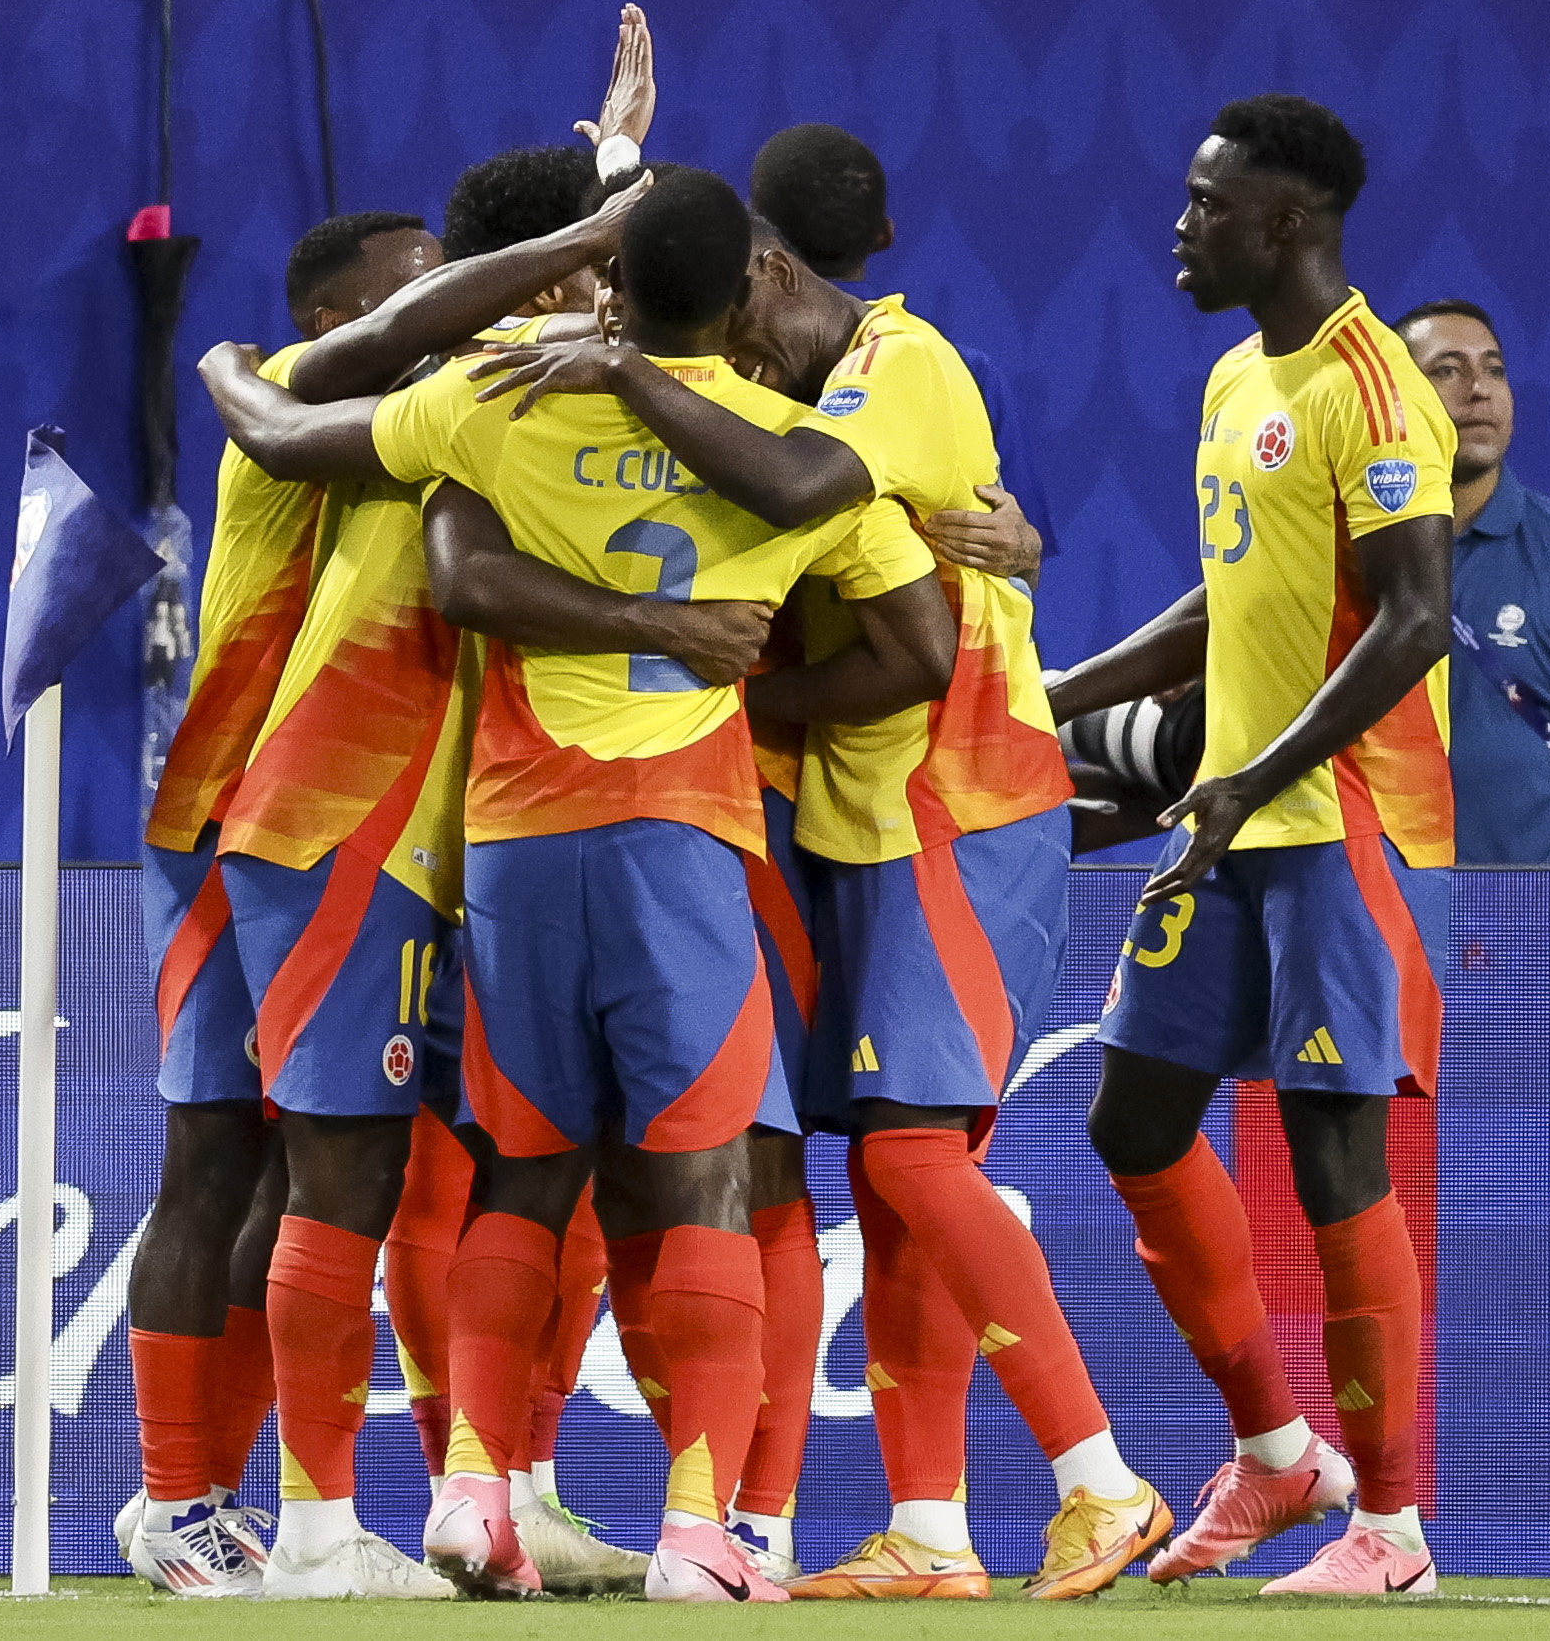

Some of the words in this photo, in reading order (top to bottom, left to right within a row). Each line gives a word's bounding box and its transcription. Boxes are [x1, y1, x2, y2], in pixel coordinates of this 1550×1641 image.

[573, 446, 604, 488] C.
[615, 450, 712, 495] CUE
[1372, 472, 1410, 485] VIBRA
[1201, 474, 1253, 565] 23
